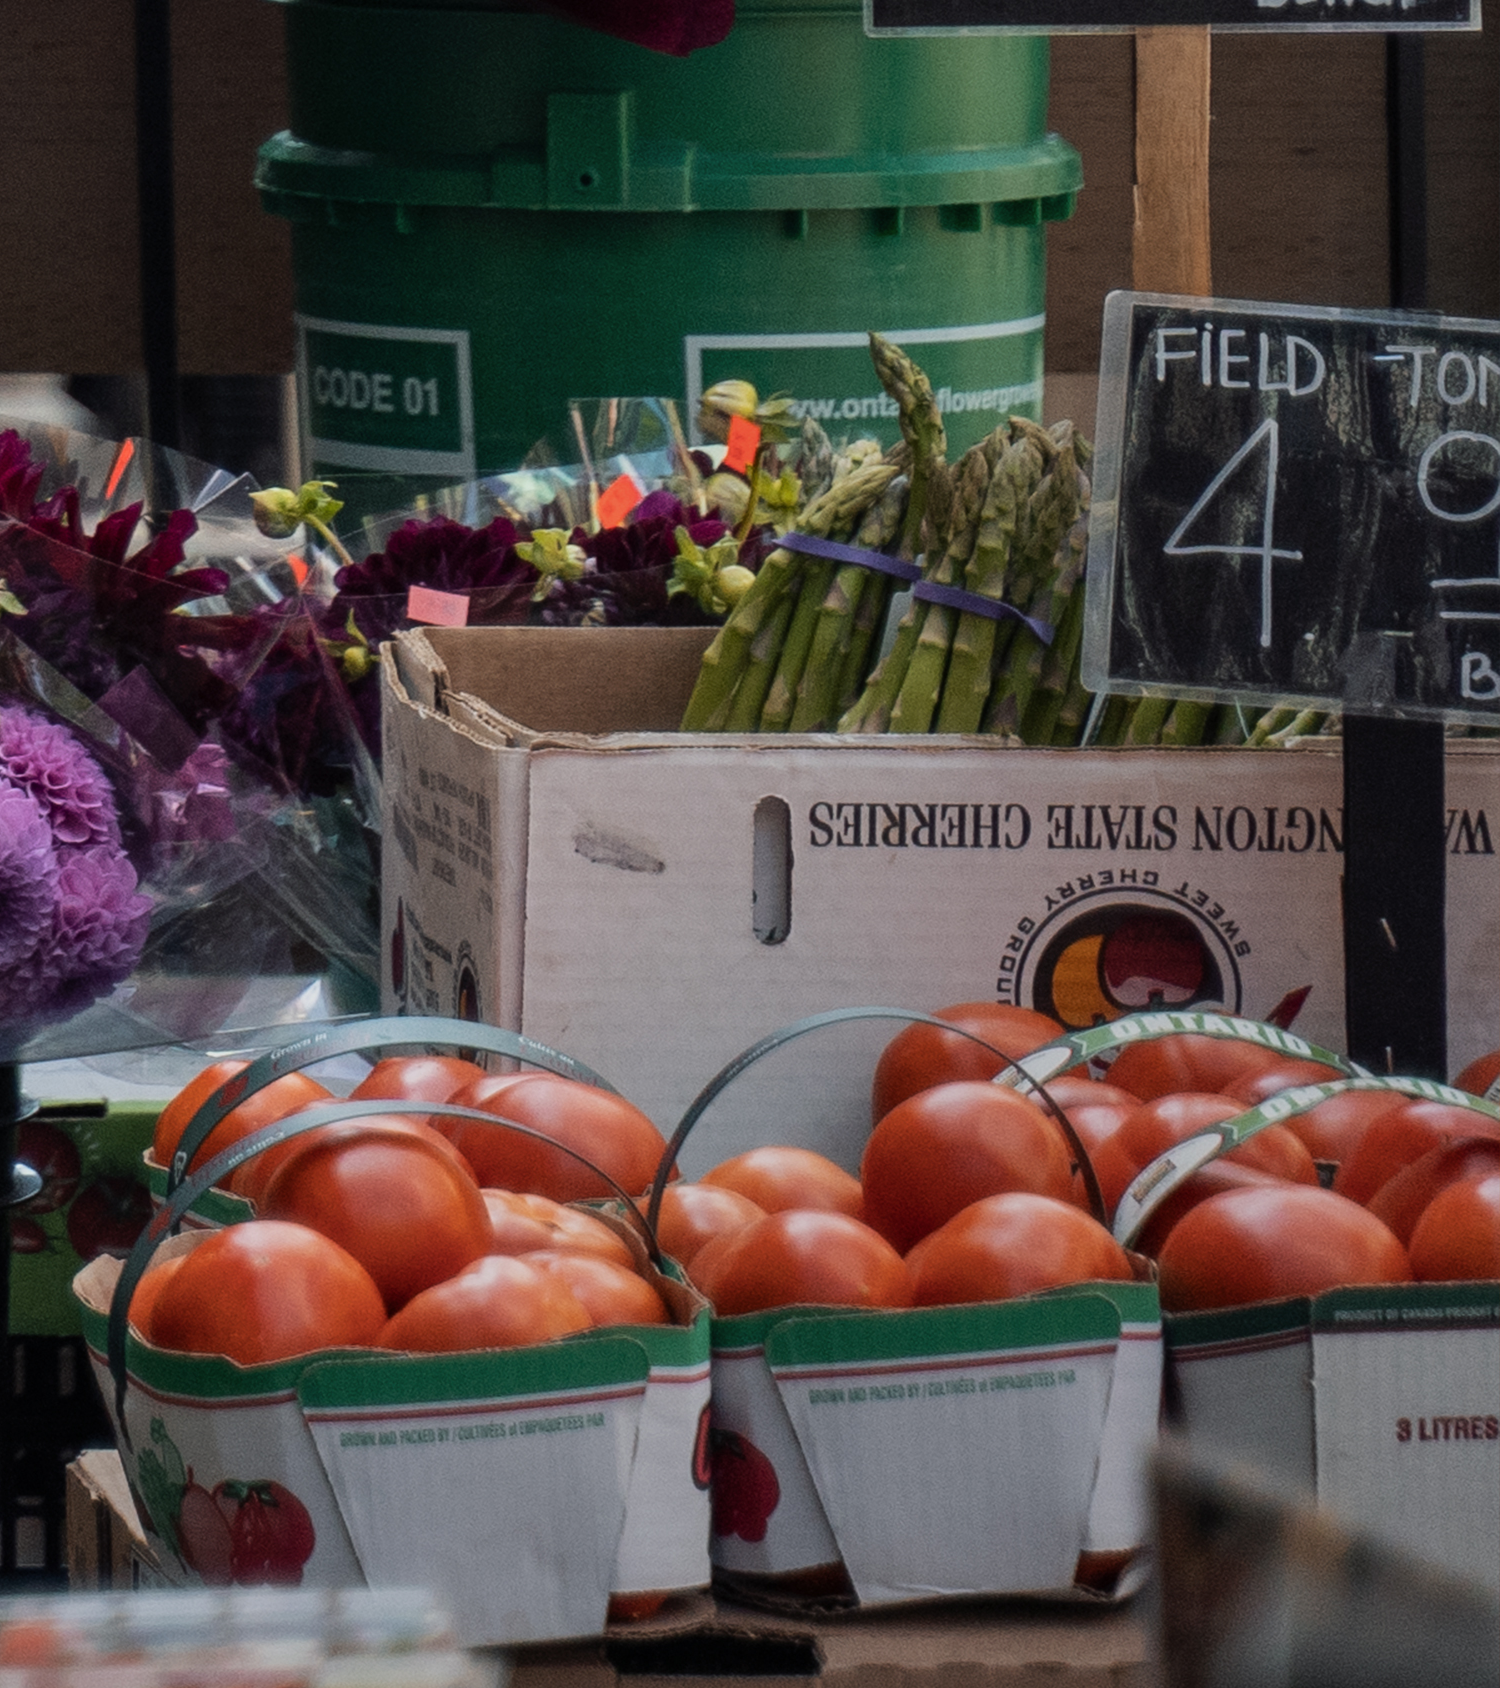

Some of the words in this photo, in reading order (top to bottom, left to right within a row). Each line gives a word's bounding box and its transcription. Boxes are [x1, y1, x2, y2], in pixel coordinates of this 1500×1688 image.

[314, 364, 395, 413] CODE
[402, 376, 439, 417] 01
[808, 801, 1032, 851] CHERRIES
[1047, 803, 1178, 852] STATE
[1043, 868, 1160, 912] CHERRY
[1174, 880, 1252, 959] SWEET
[1108, 1012, 1313, 1057] ONTARIO
[1259, 1075, 1472, 1120] ONTARIO
[1396, 1416, 1412, 1443] 3
[1418, 1414, 1499, 1441] LITRES
